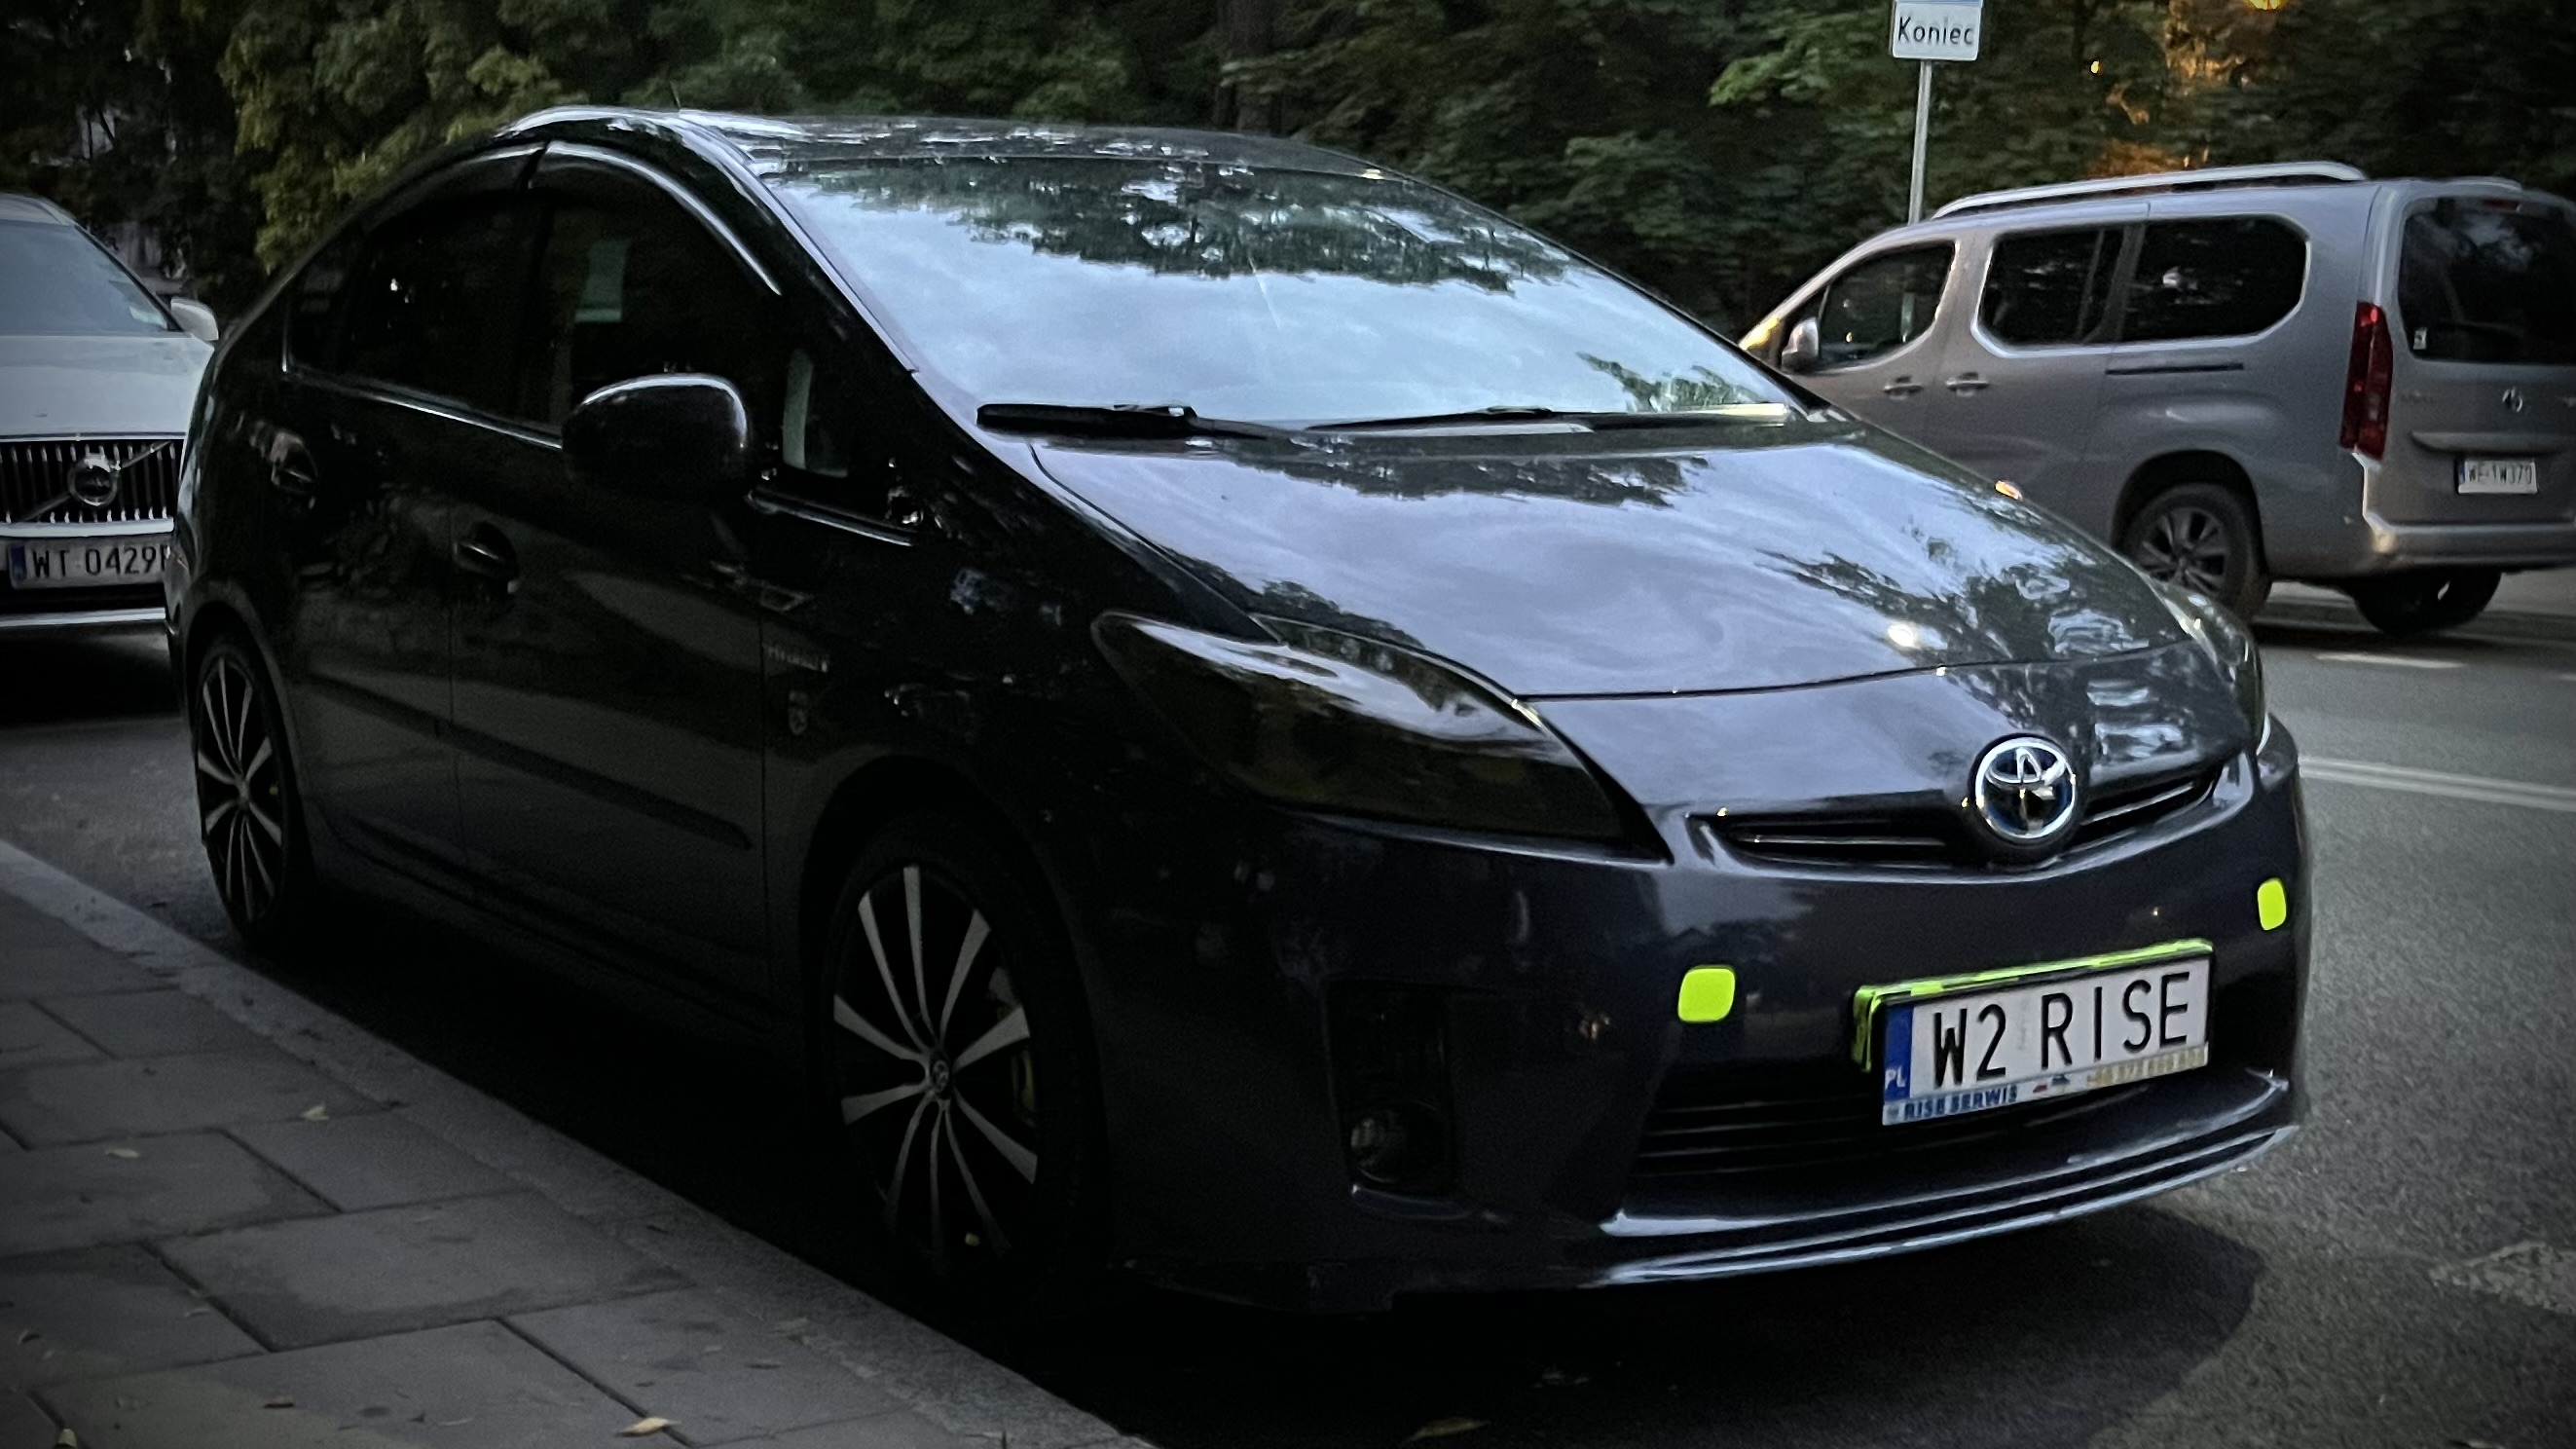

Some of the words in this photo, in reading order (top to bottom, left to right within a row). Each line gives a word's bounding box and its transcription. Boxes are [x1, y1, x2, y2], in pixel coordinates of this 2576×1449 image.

[1897, 16, 1972, 45] Koniec
[32, 549, 70, 578] WT
[1933, 1003, 2006, 1088] W2
[2041, 971, 2190, 1071] RISE
[1885, 1068, 1907, 1091] PL
[1904, 1097, 1946, 1121] RISE
[1949, 1085, 2018, 1113] SERWIS
